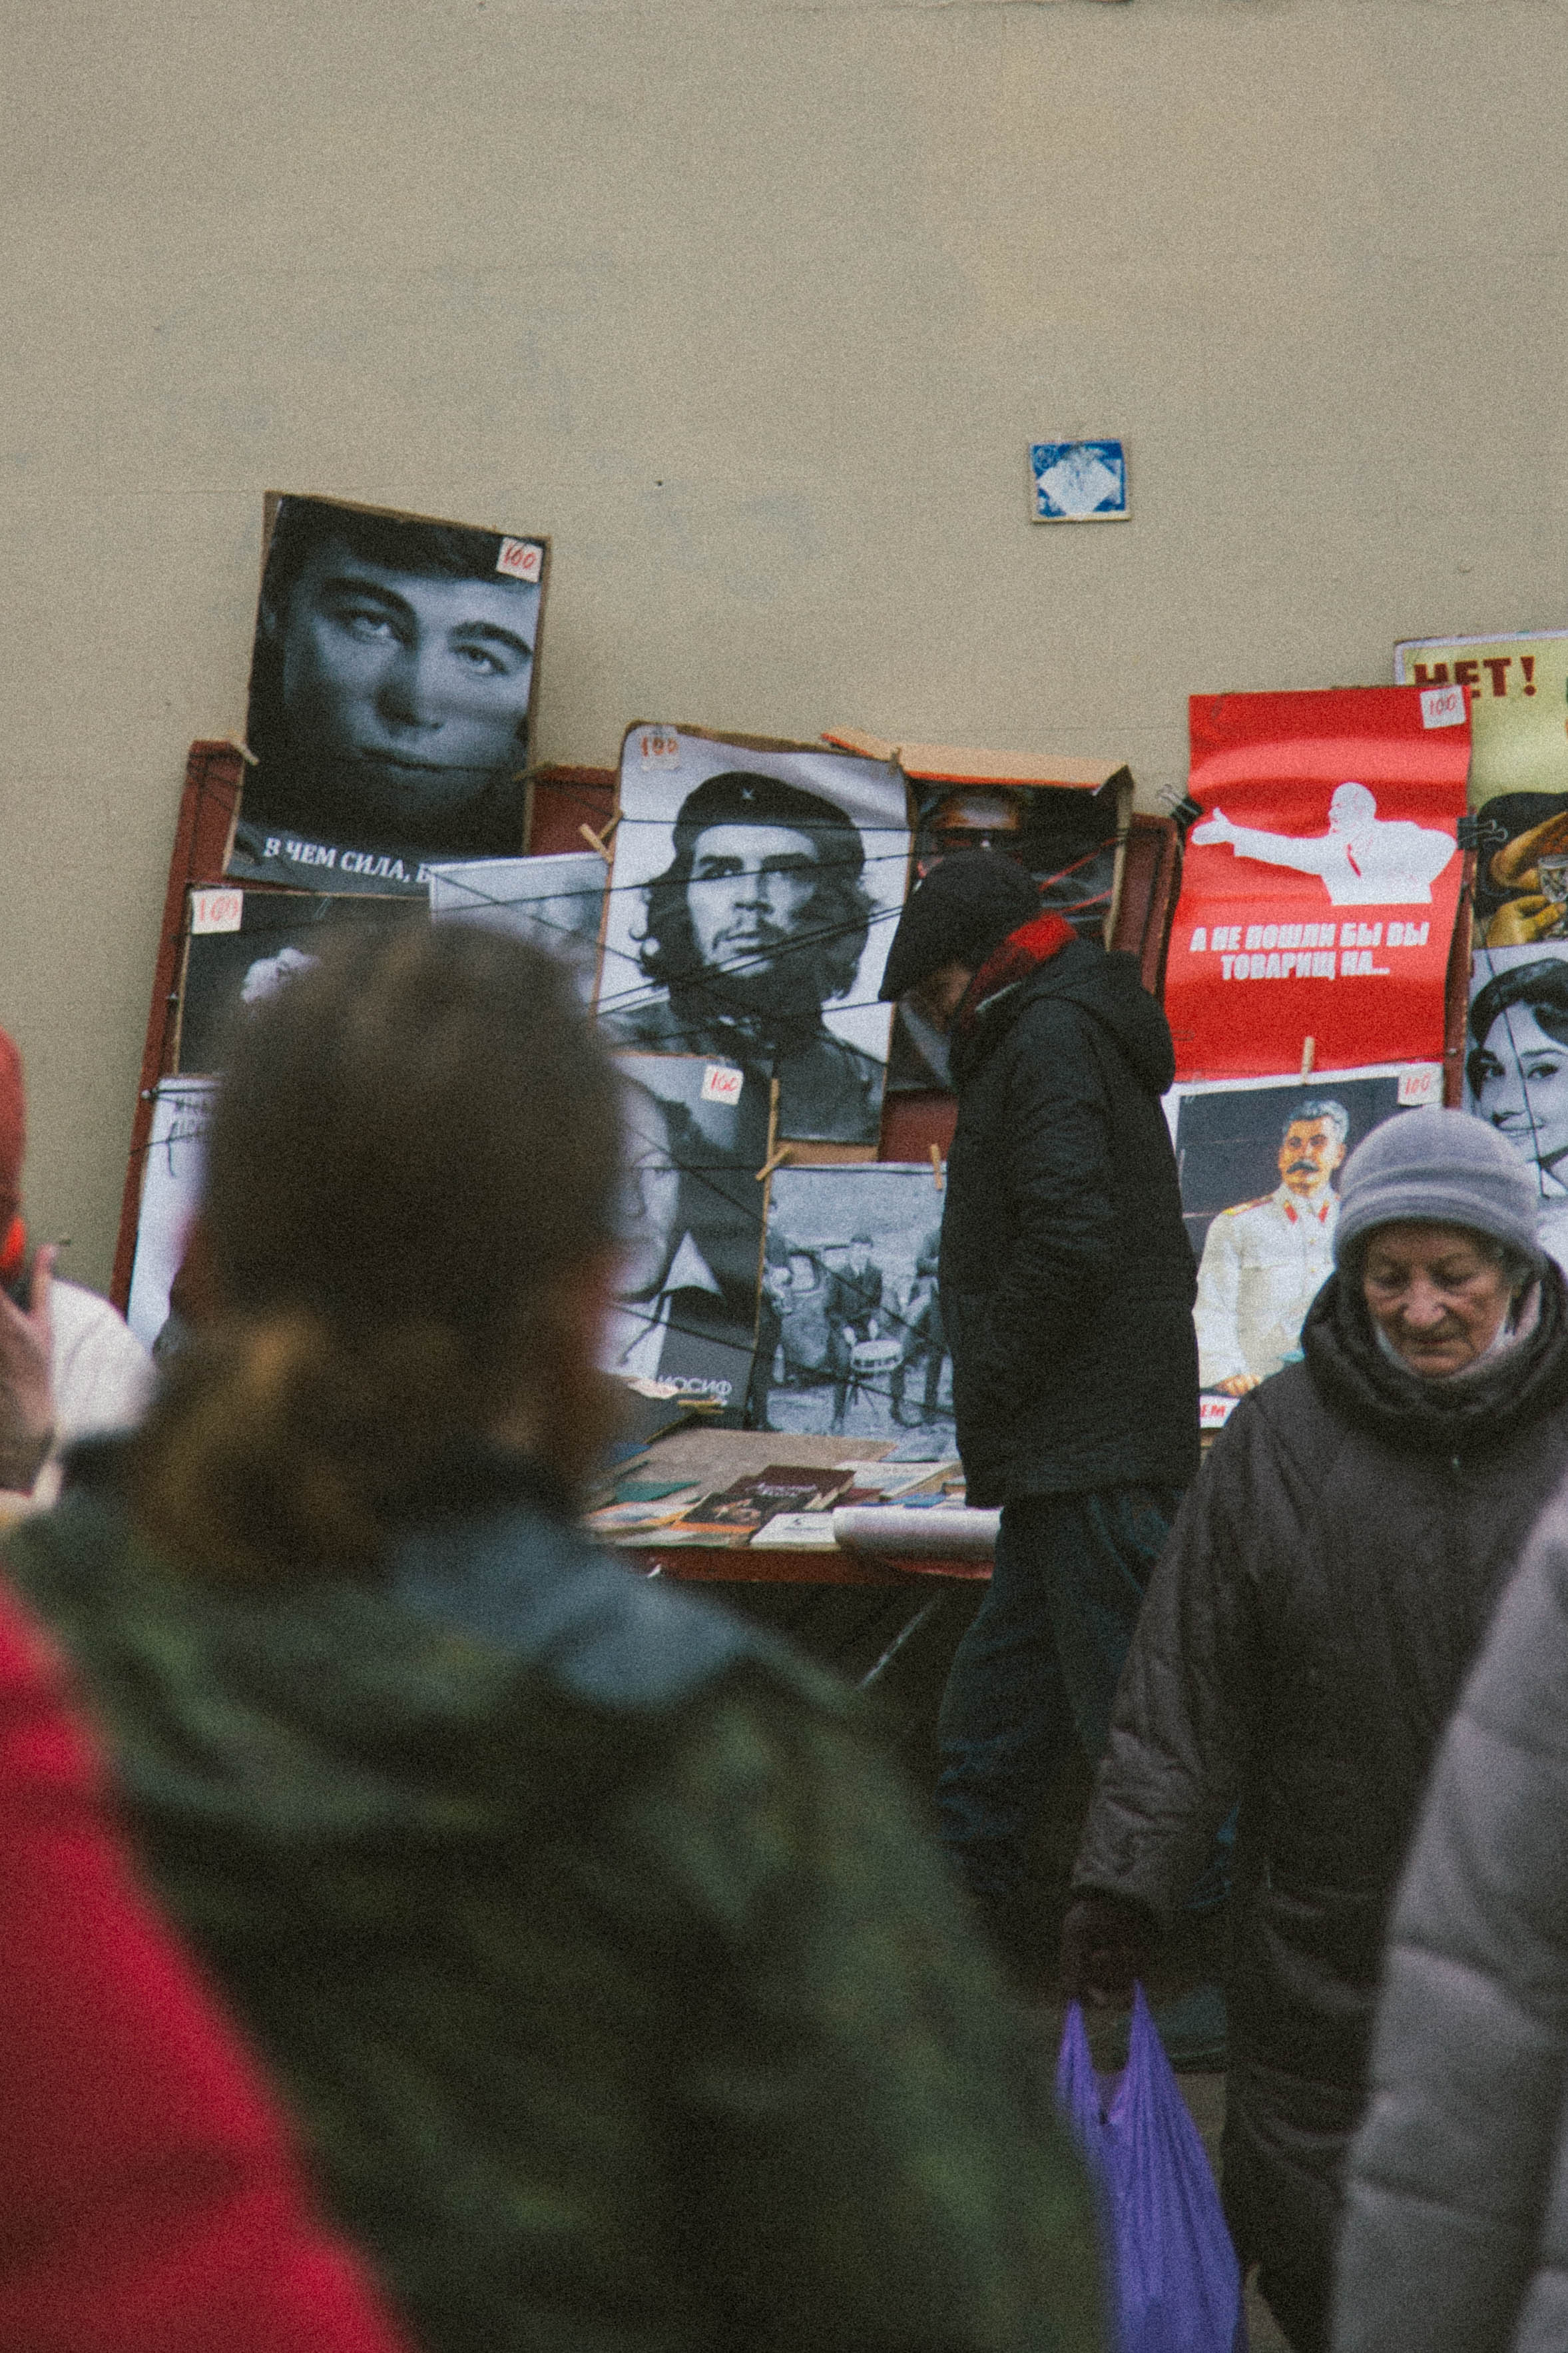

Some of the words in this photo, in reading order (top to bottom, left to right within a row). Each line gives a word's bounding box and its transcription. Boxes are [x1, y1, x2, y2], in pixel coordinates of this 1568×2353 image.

[503, 542, 537, 569] 100
[1429, 693, 1457, 717] 100
[641, 736, 678, 757] 100
[263, 837, 281, 857] В
[286, 839, 337, 868] ЧЕМ
[340, 850, 411, 883] СИЛА,
[199, 896, 239, 922] 100
[1189, 926, 1207, 952] А
[1211, 926, 1242, 951] НЕ
[1244, 922, 1336, 950] ПОШЛИ
[1340, 922, 1383, 948] БЫ
[1386, 921, 1430, 946] ВЫ
[1220, 950, 1336, 980] ТОВАРИЩ
[710, 1071, 737, 1092] 100
[1405, 1072, 1432, 1096] 100
